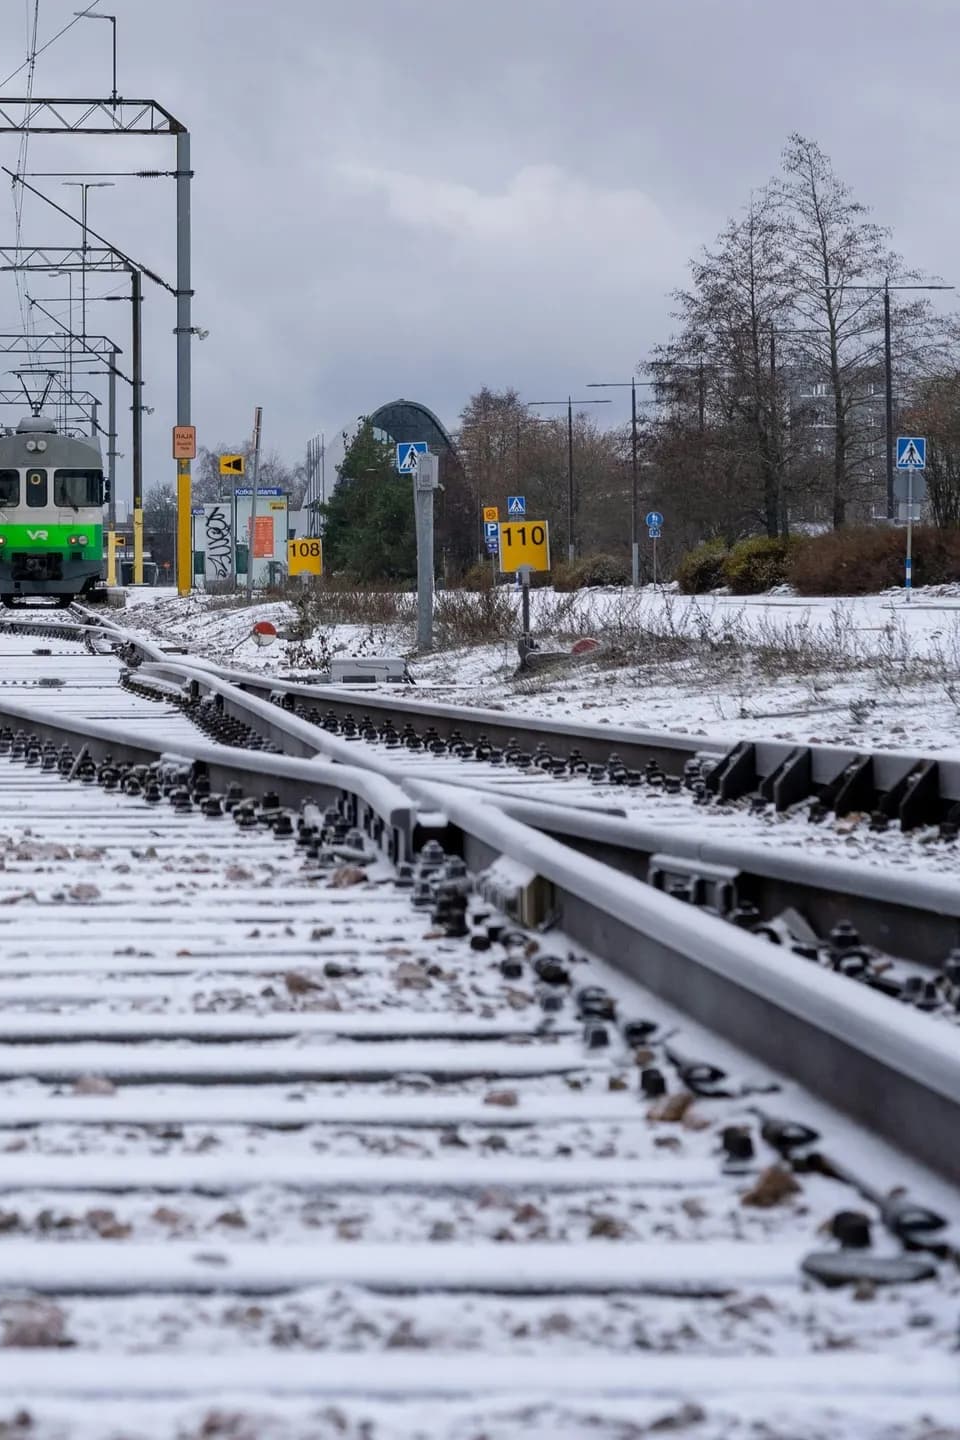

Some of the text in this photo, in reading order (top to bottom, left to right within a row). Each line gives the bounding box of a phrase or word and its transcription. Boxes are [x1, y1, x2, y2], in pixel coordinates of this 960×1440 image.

[27, 530, 48, 540] VR
[487, 523, 497, 536] P
[503, 526, 544, 546] 110
[290, 542, 320, 558] 108
